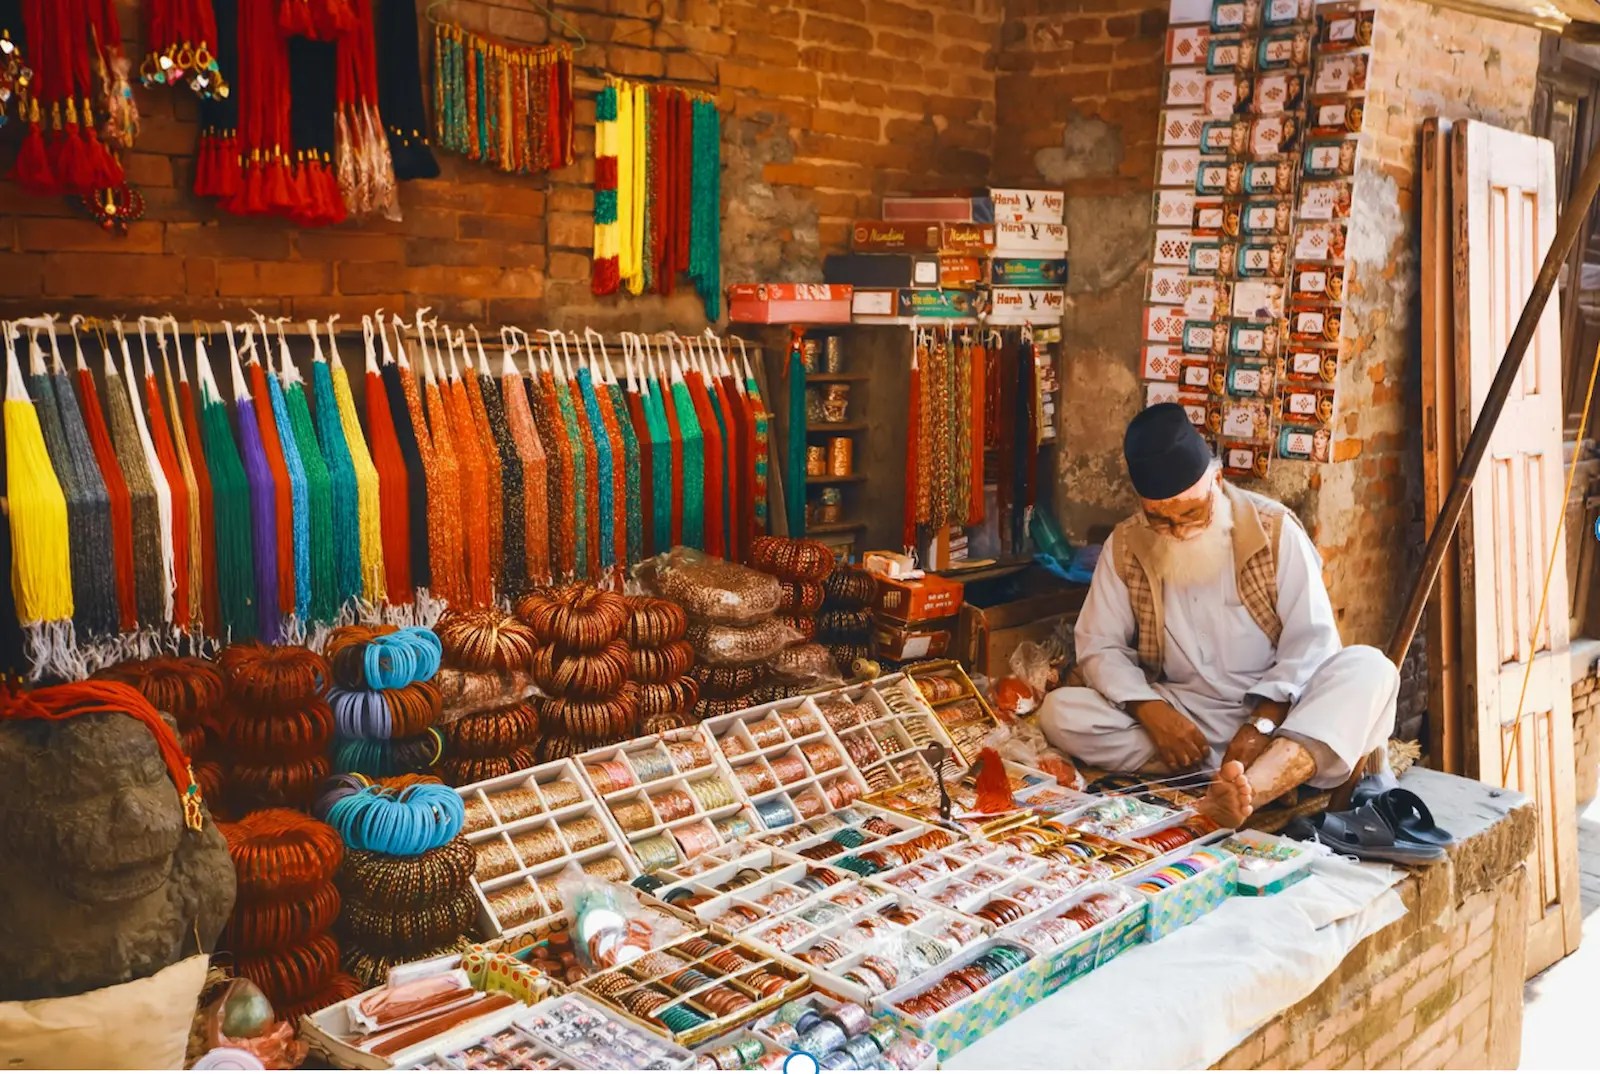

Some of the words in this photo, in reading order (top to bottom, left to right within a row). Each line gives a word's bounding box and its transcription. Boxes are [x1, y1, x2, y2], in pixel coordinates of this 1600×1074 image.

[994, 193, 1021, 205] Harsh
[1042, 194, 1062, 208] Ajay
[996, 292, 1023, 304] Harsh
[1043, 292, 1062, 306] Ajay
